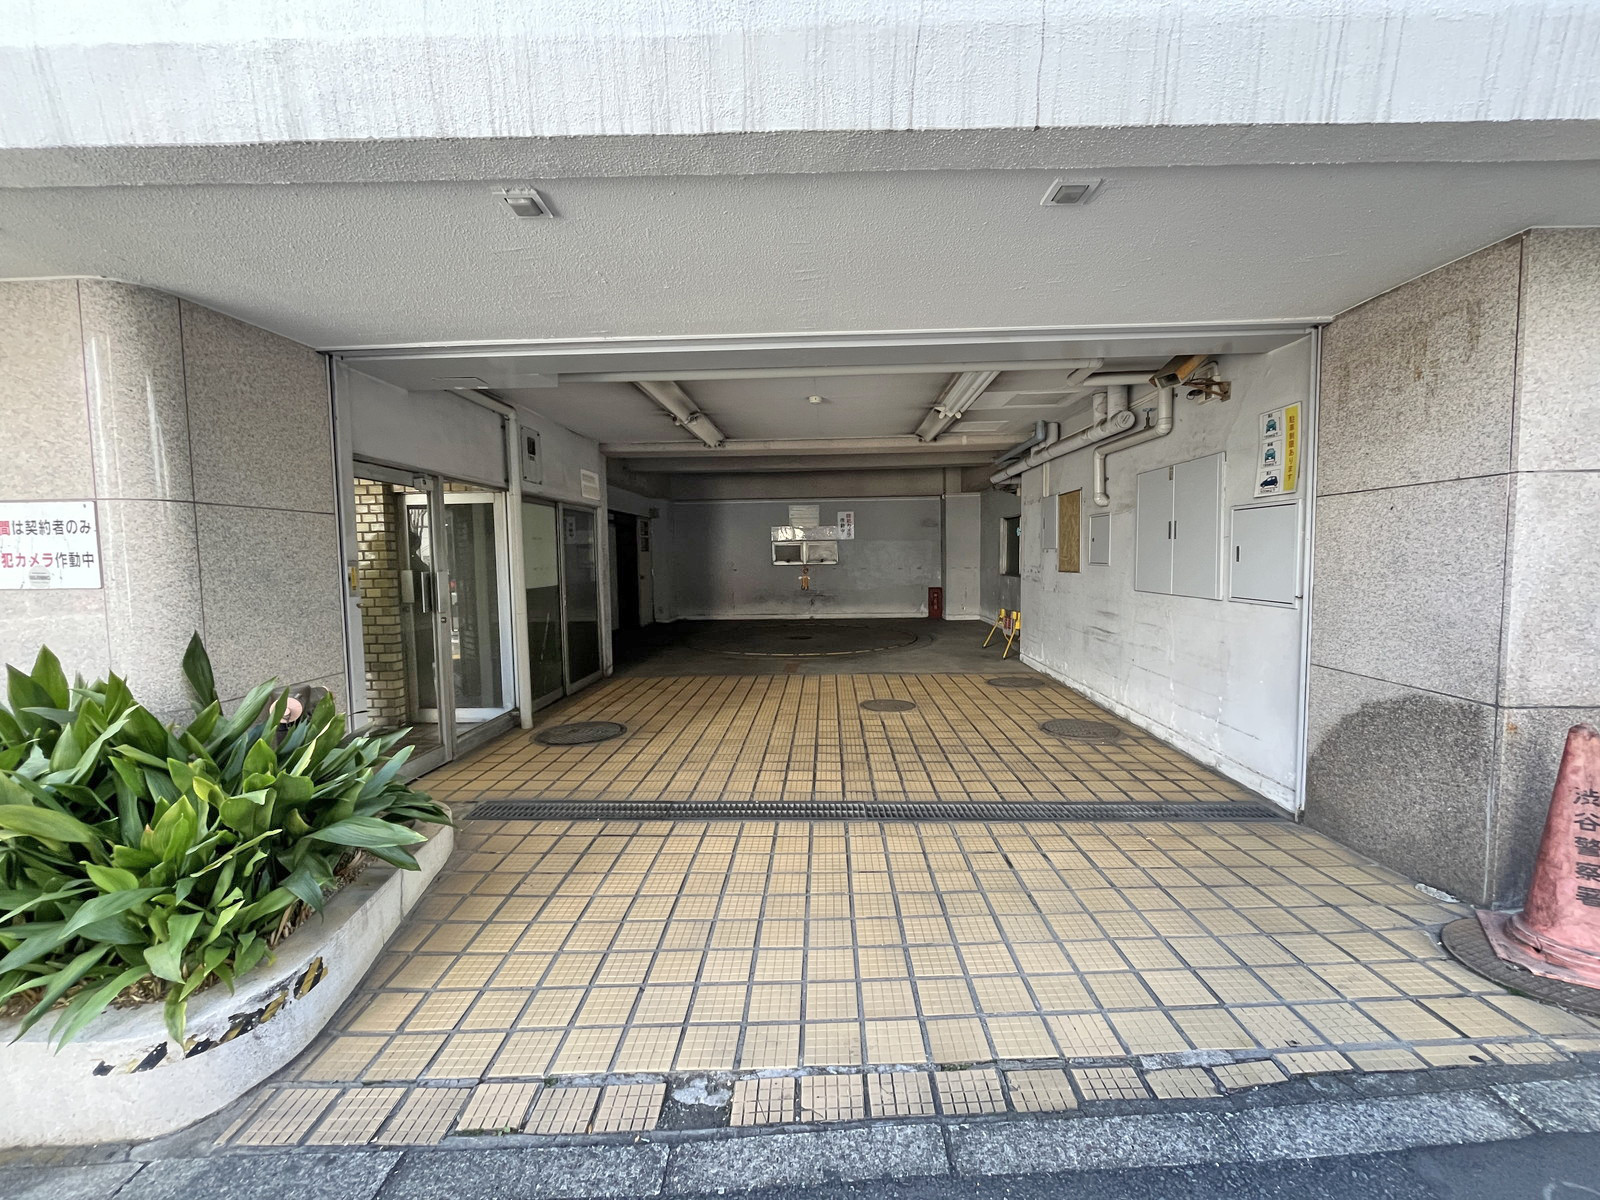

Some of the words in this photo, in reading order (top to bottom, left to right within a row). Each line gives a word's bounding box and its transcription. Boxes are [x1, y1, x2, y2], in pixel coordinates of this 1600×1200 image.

[0, 520, 91, 536] 間は契約者のみ
[1, 551, 94, 569] 犯カメラ作動中
[1573, 787, 1600, 908] 渋谷警察署
